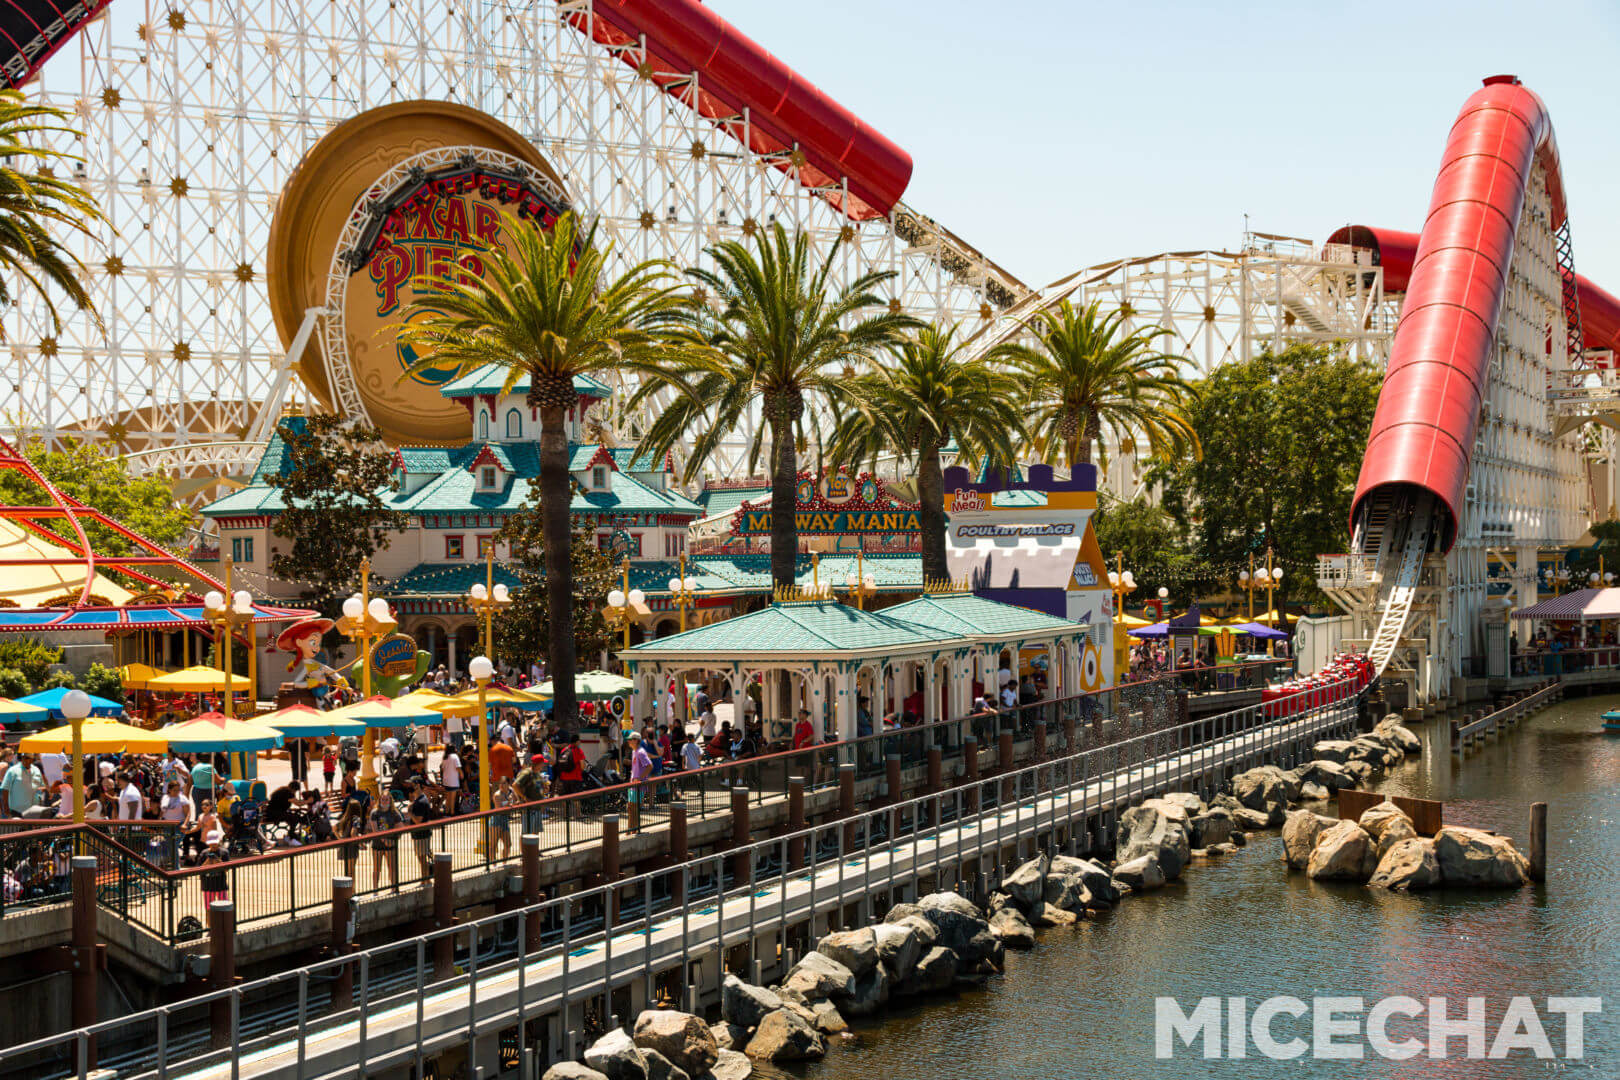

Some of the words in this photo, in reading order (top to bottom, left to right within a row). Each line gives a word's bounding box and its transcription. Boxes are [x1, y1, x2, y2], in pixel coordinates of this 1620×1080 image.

[369, 244, 486, 317] PIER
[827, 478, 848, 490] TOY
[955, 488, 977, 500] Fun
[952, 499, 985, 513] Meal!
[847, 513, 921, 530] MANIA
[958, 525, 1018, 537] POULTRY
[1019, 524, 1075, 536] PALACE
